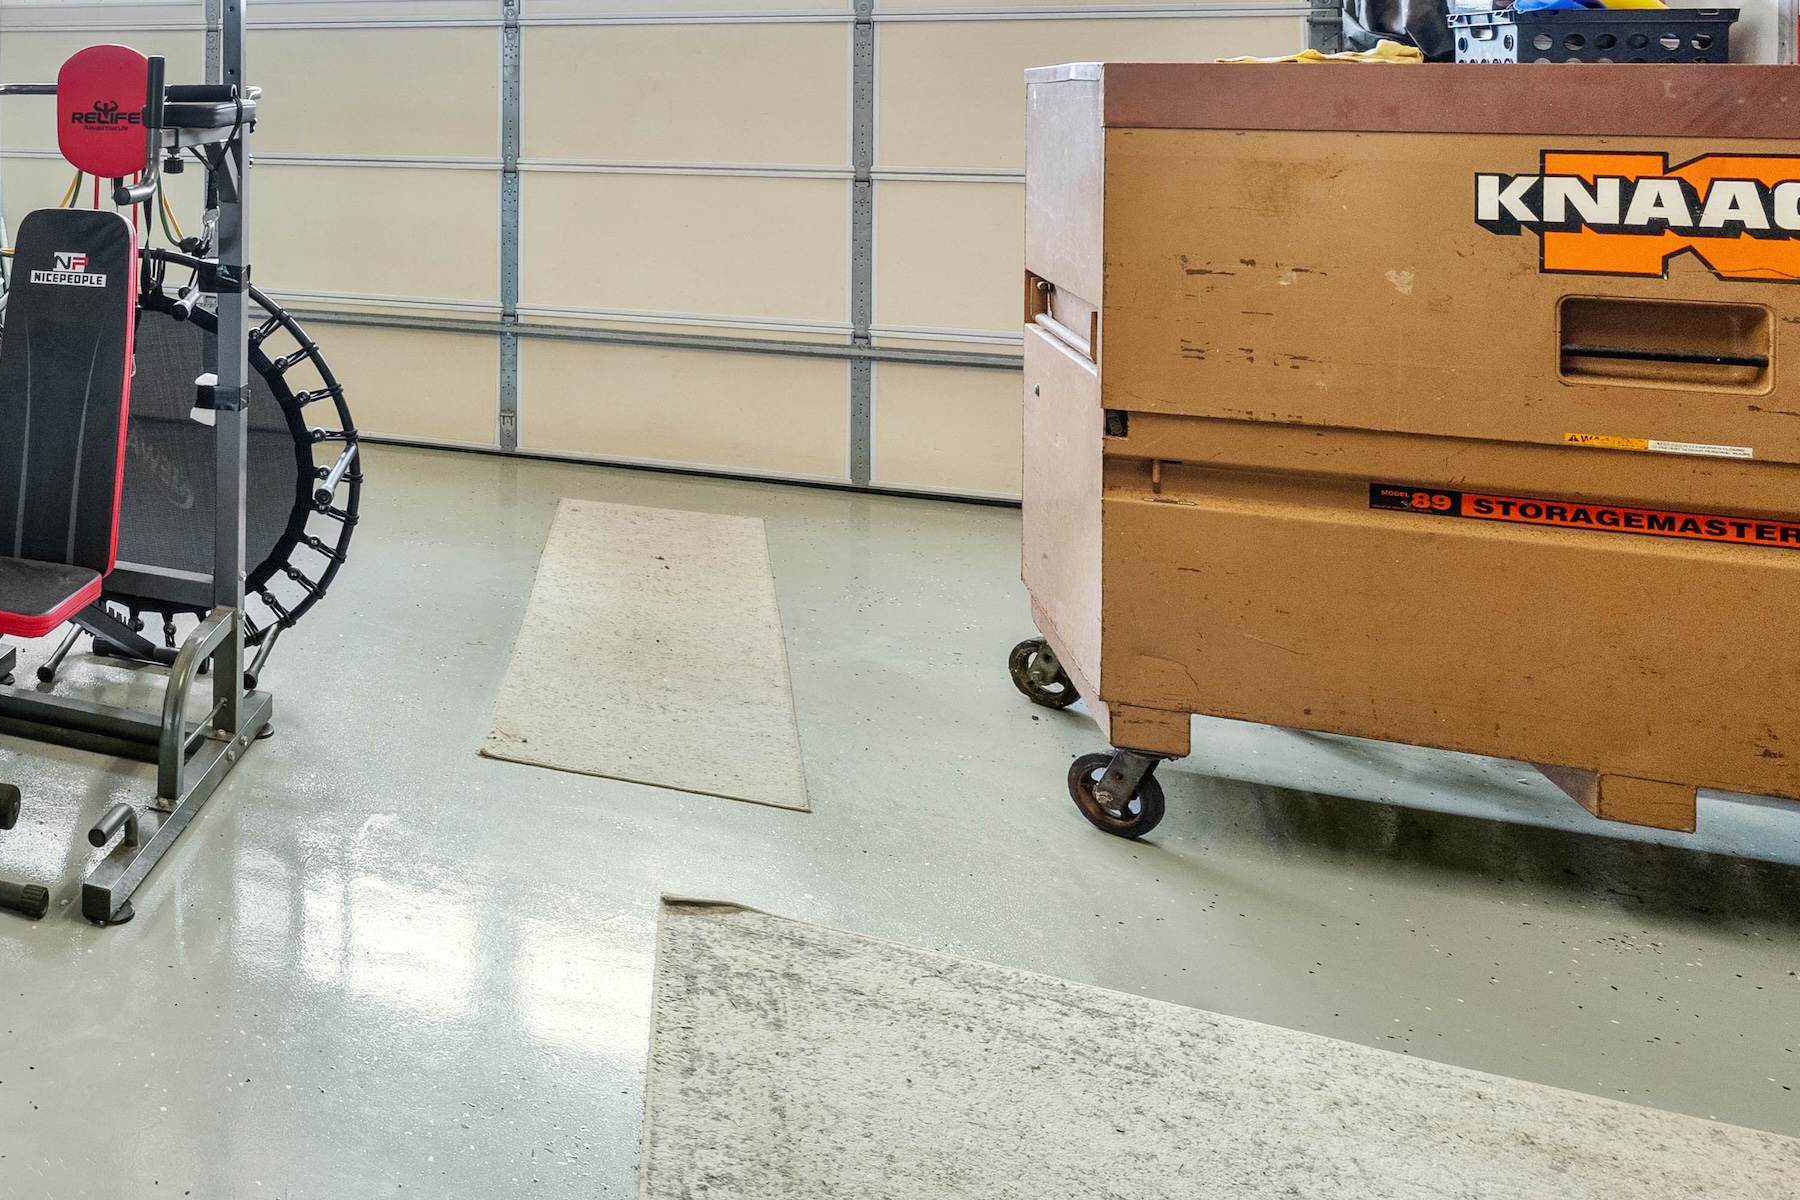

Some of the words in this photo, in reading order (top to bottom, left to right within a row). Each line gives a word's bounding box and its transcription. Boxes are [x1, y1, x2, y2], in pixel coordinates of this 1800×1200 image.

[71, 112, 141, 124] RELIFE
[34, 272, 103, 286] NICEPEOPLE
[1380, 489, 1410, 498] MODEL
[1411, 492, 1452, 511] 89
[1473, 498, 1800, 543] STORAGEMASTER
